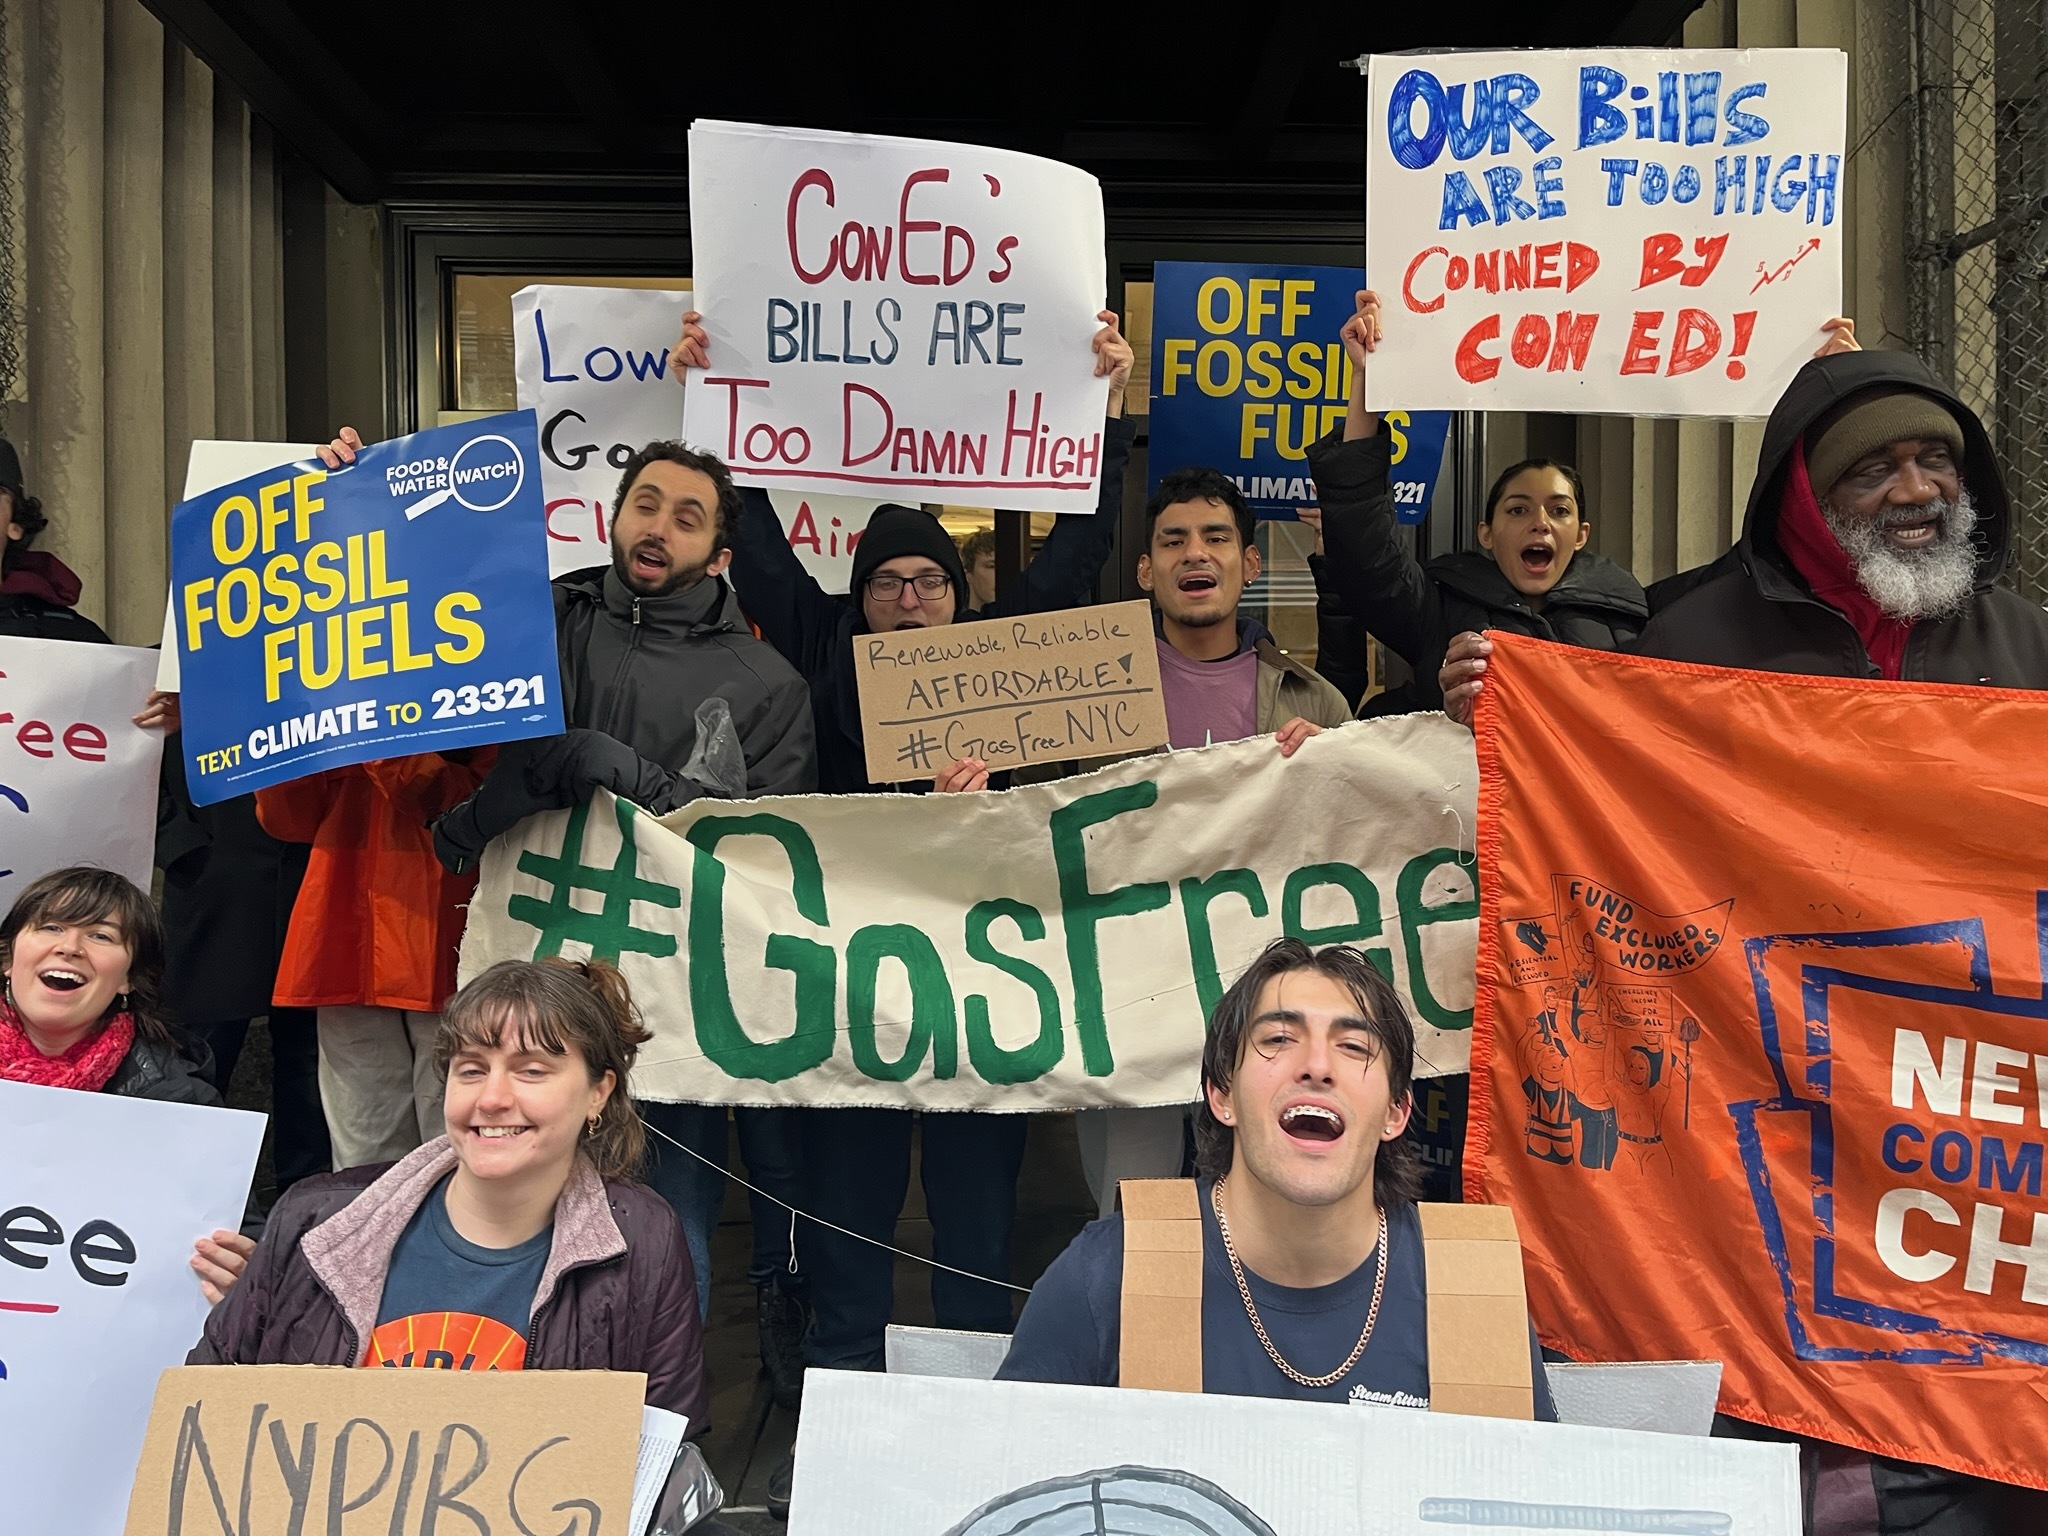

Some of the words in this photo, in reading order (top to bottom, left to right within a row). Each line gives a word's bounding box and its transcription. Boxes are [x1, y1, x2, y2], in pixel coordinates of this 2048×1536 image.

[1388, 69, 1556, 169] OUR
[1439, 157, 1567, 230] ARE
[1601, 158, 1702, 207] TOO
[1714, 153, 1840, 227] HIGH
[767, 297, 902, 366] BILLS
[928, 300, 1026, 366] ARE
[1196, 277, 1315, 336] OFF
[1455, 310, 1600, 384] CON
[1619, 308, 1758, 381] ED!
[388, 473, 448, 497] WATER
[454, 460, 518, 485] WATCH
[211, 470, 328, 566] OFF
[183, 530, 409, 652] FOSSIL
[263, 591, 486, 703] FUELS
[1012, 617, 1131, 650] Reliable
[906, 652, 1133, 711] AFFORDABLE!
[196, 743, 242, 776] TEXT
[248, 699, 379, 760] CLIMATE
[385, 701, 422, 726] TO
[431, 674, 545, 720] 23321
[1570, 880, 1635, 924] FUND
[1594, 916, 1699, 951] EXCLUDED
[1618, 927, 1721, 972] WORKERS
[1642, 1007, 1658, 1016] FOR
[1643, 1018, 1663, 1027] ALL
[1891, 1027, 2048, 1130] NE
[1348, 1384, 1429, 1408] Steamfitters
[167, 1399, 603, 1536] NYPIRG
